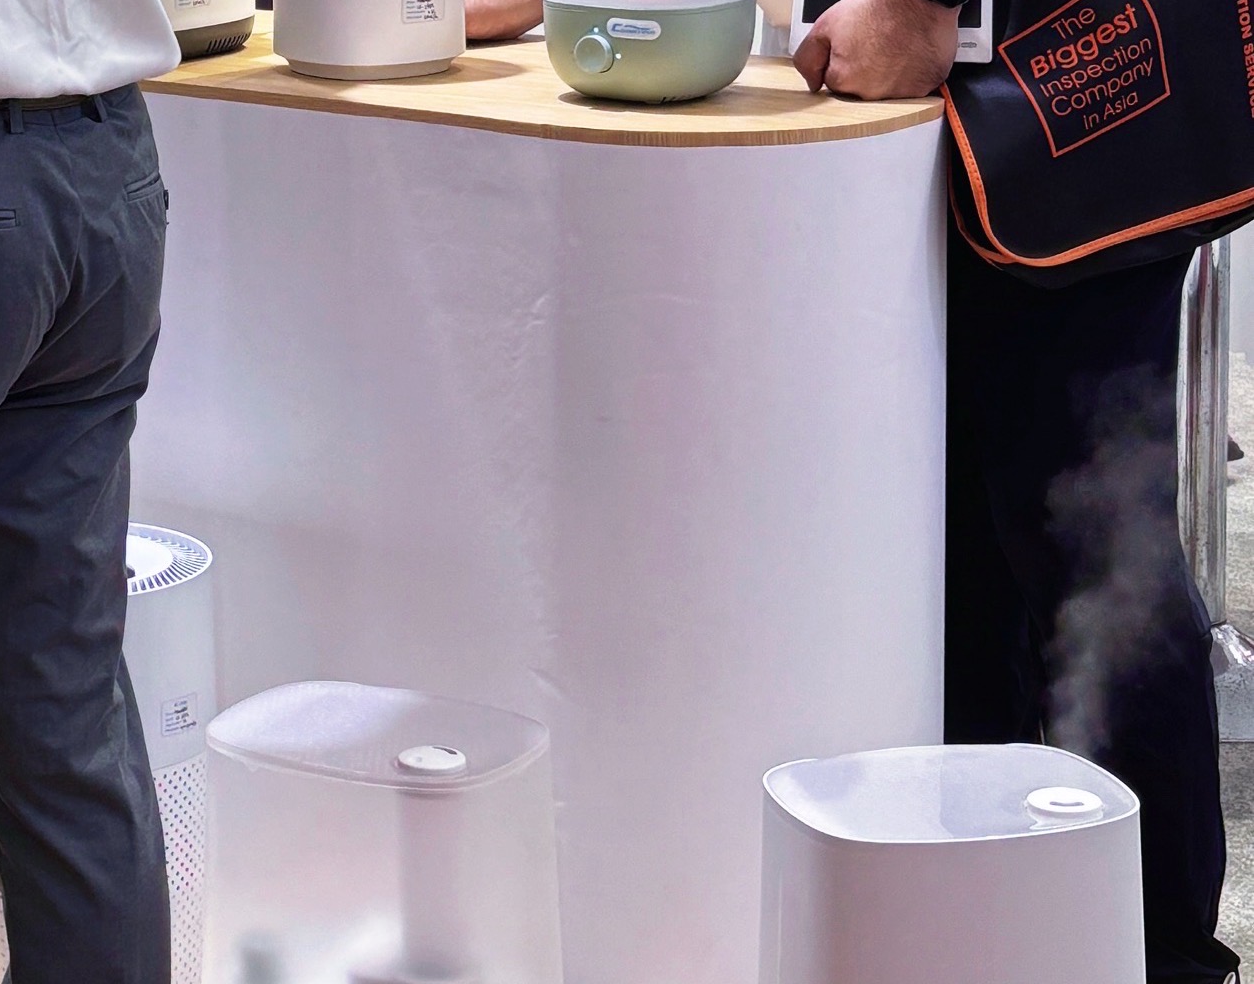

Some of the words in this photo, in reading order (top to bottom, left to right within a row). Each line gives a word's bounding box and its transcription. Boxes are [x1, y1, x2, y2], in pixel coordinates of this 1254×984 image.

[1030, 3, 1138, 79] Biggest
[1050, 7, 1096, 40] The
[1039, 38, 1152, 97] Inspection
[1051, 57, 1154, 116] Company
[1103, 91, 1138, 121] Asia
